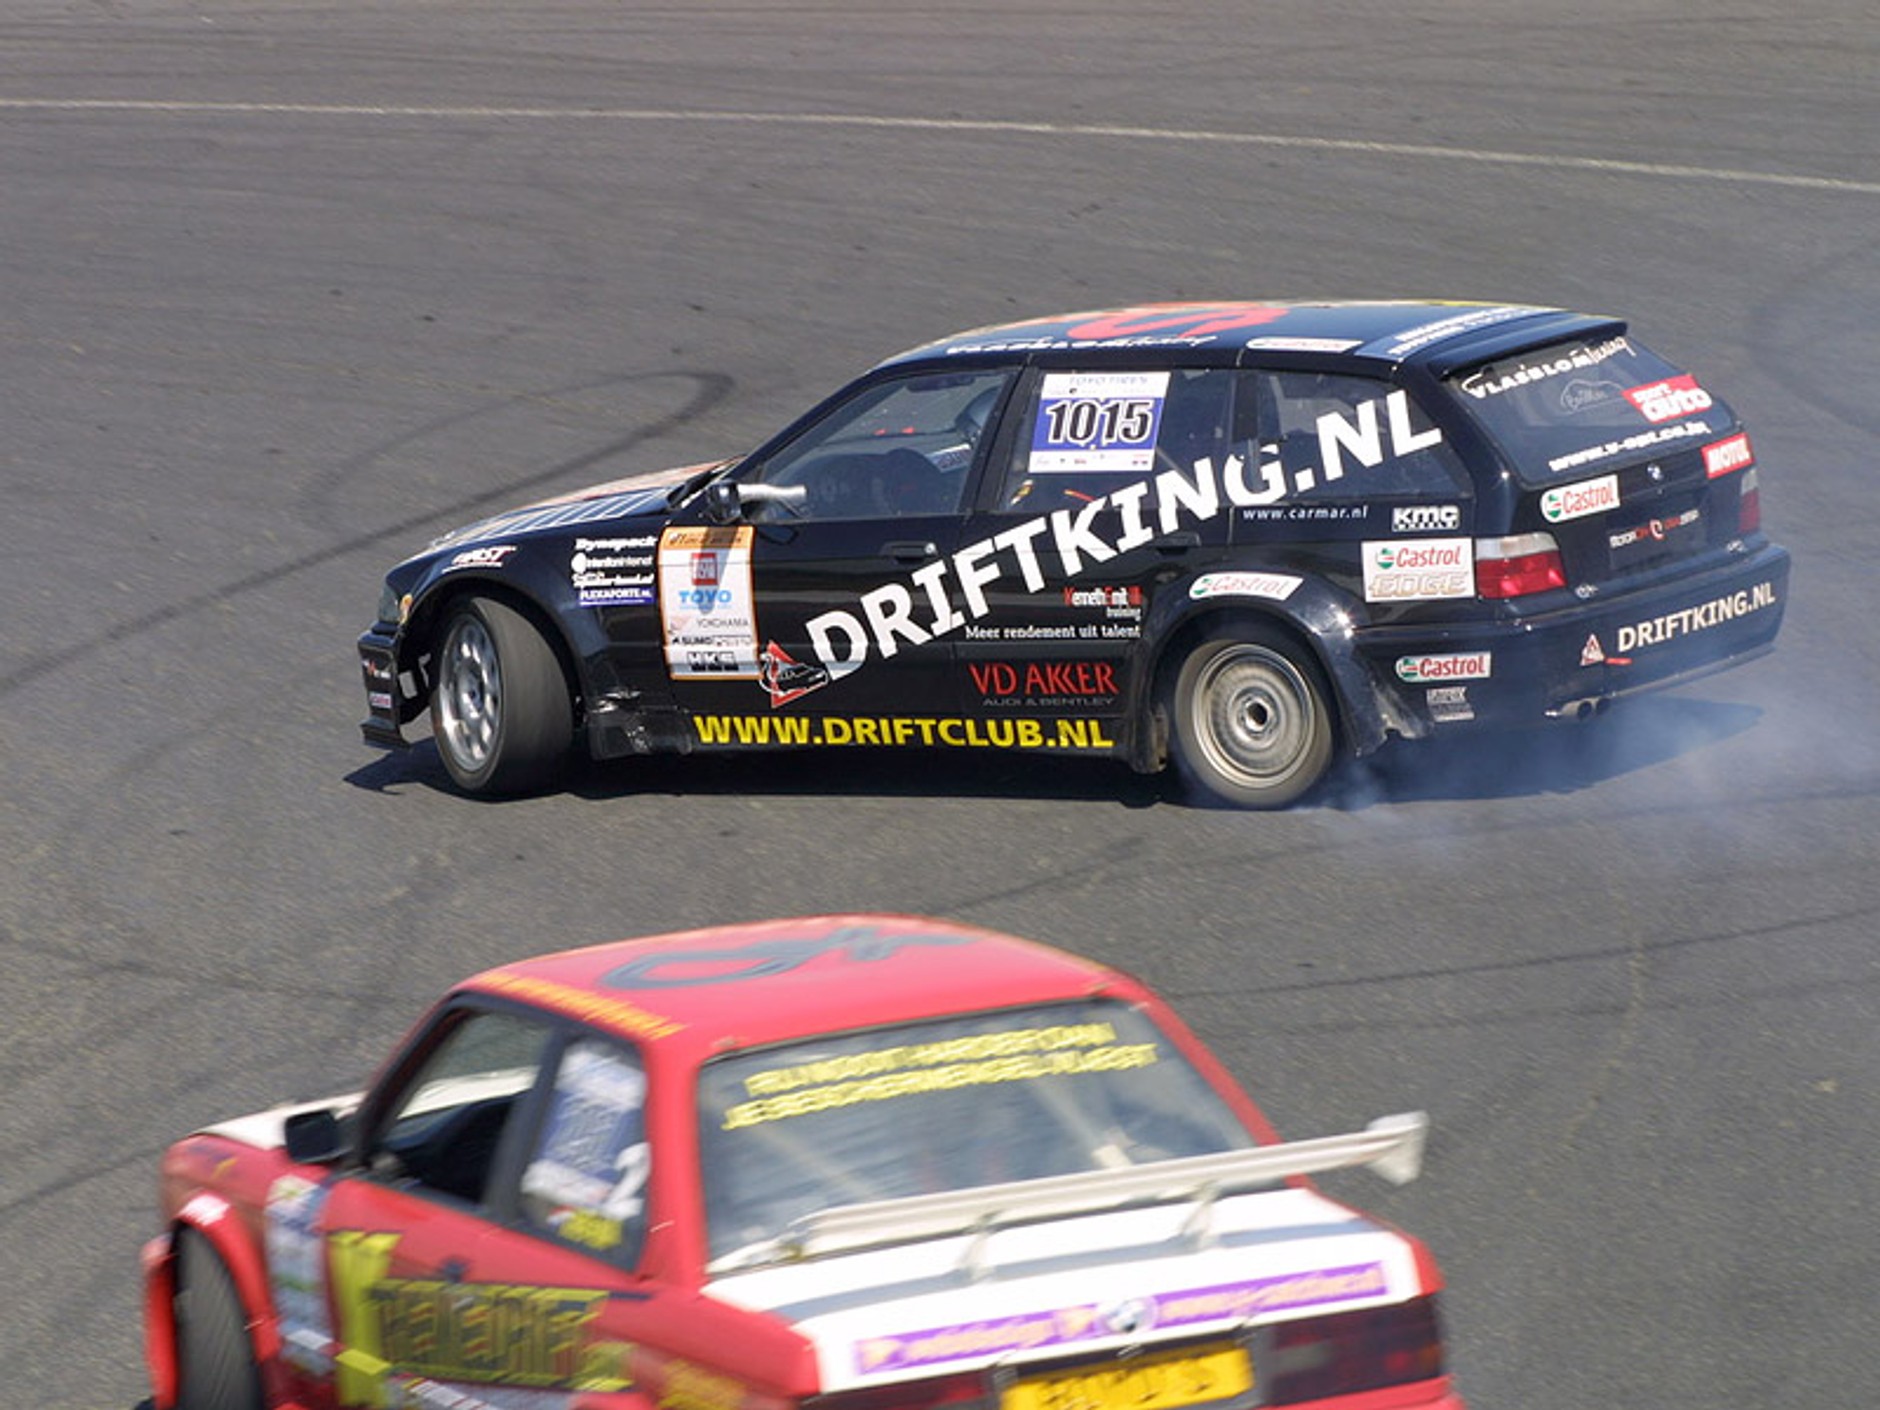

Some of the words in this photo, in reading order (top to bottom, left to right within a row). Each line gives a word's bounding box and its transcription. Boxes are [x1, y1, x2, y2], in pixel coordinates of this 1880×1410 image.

[1046, 399, 1155, 446] 1015
[1563, 482, 1614, 513] Castrol
[1243, 504, 1369, 520] www.carmar.nl
[805, 389, 1442, 681] DRIFTKING.NL
[1396, 546, 1461, 568] Castrol
[678, 590, 732, 603] TOYO
[1212, 577, 1290, 596] Castrol
[1368, 571, 1468, 599] EDGE
[1618, 582, 1775, 652] DRIFTKING.NL
[965, 626, 1000, 639] Meer
[1003, 625, 1076, 639] rendement
[1079, 625, 1097, 638] uit
[1101, 624, 1141, 638] talent
[968, 661, 1018, 695] VD
[1024, 661, 1119, 695] AKKER
[1420, 658, 1485, 678] Castrol
[694, 715, 1113, 749] WWW.DRIFTCLUB.NL
